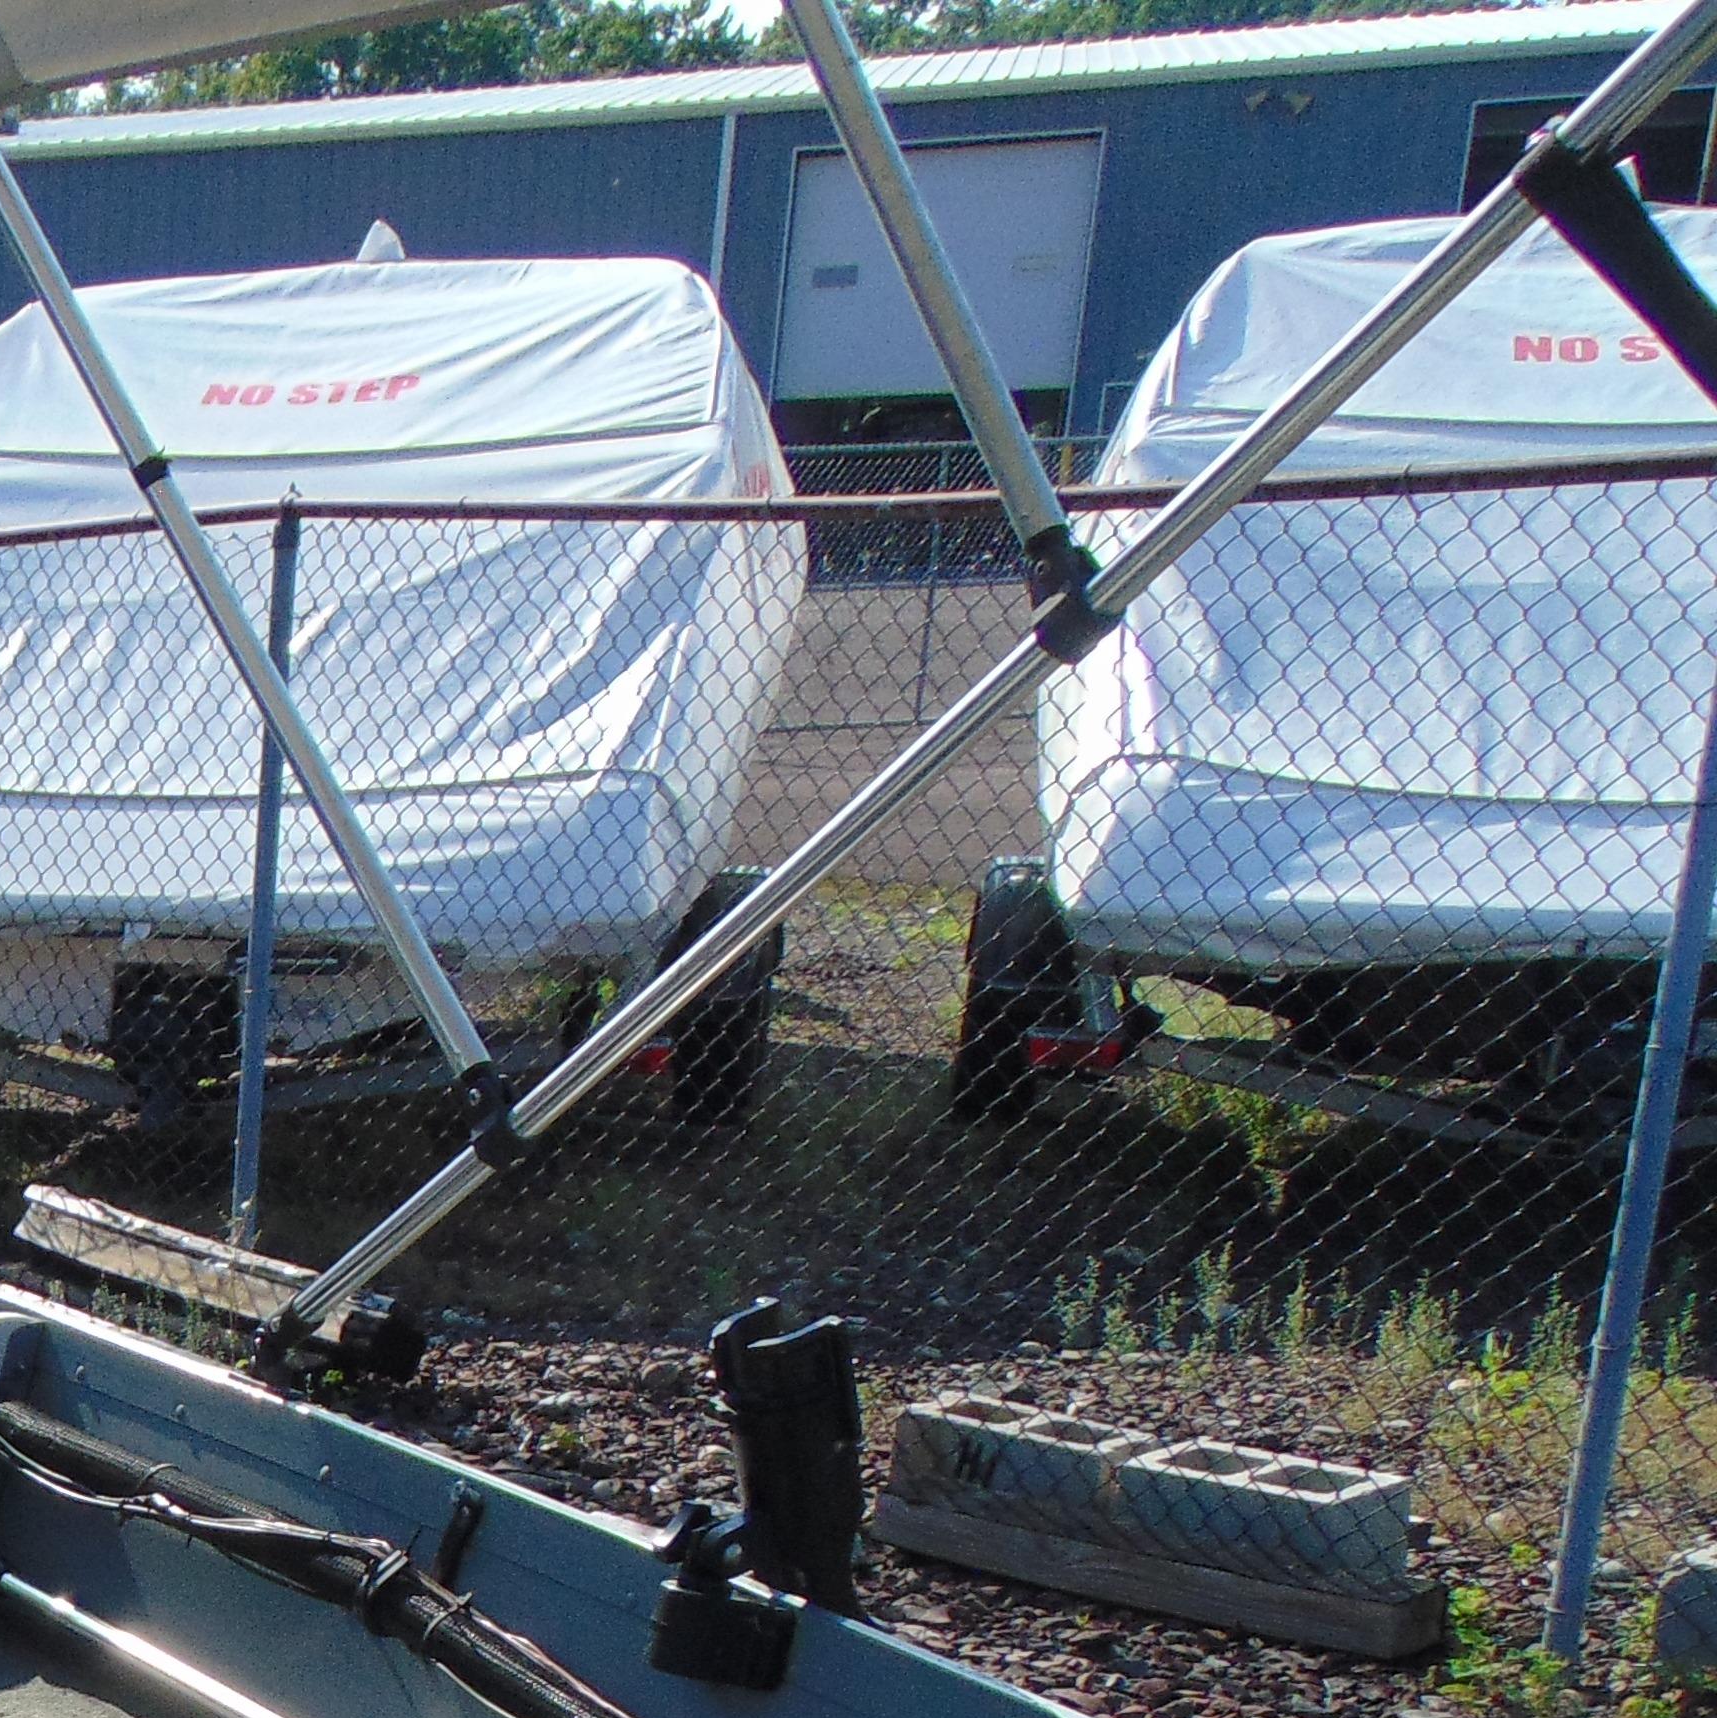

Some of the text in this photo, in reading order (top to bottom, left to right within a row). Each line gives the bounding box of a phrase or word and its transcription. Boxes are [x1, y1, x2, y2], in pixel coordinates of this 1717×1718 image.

[1514, 336, 1600, 362] NO
[201, 375, 420, 406] NO STEP
